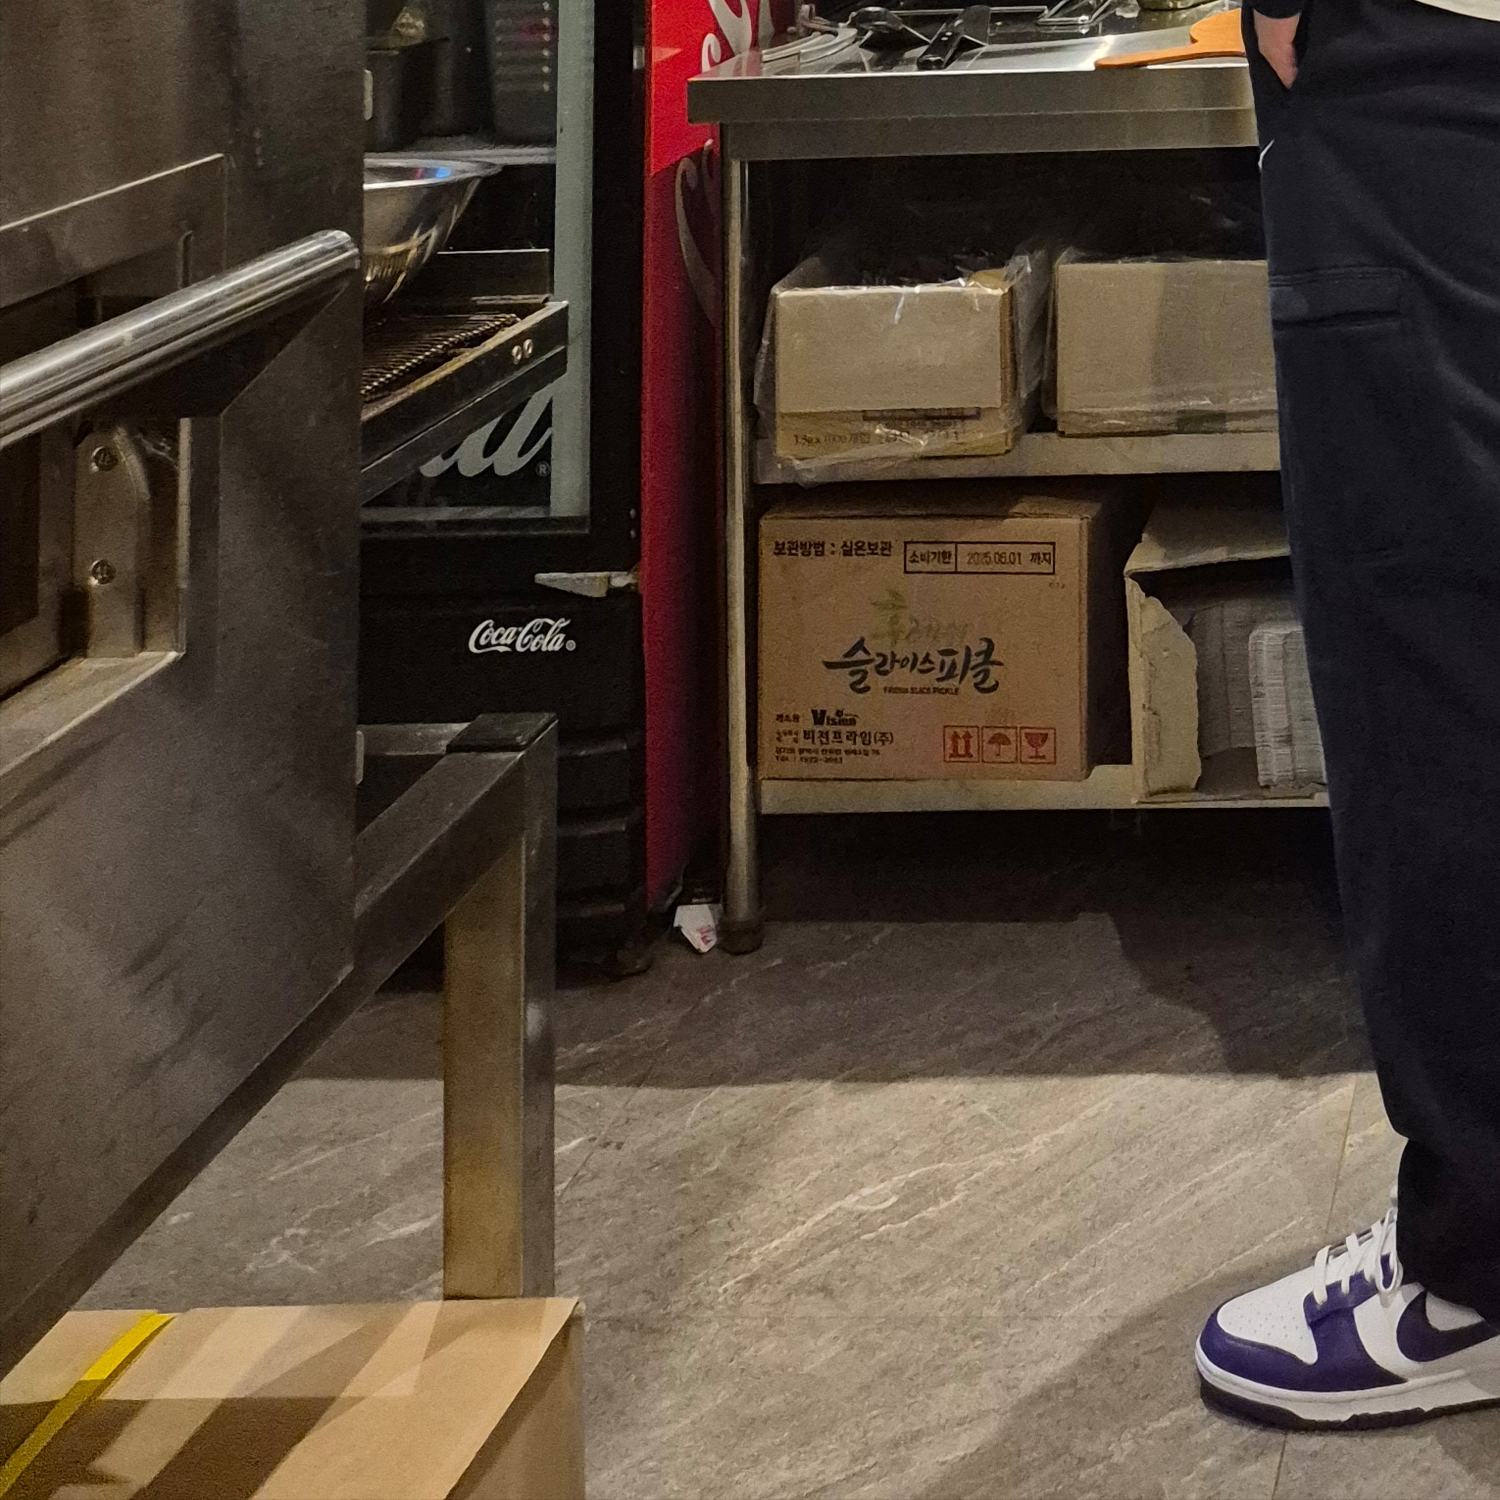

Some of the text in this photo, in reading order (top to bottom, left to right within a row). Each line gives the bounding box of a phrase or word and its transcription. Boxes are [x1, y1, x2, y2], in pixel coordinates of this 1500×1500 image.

[774, 541, 825, 557] 보관방법
[841, 541, 893, 557] 실온보관
[908, 550, 952, 564] 소비기한
[1029, 551, 1052, 565] 까지
[468, 618, 571, 654] Coca-Cola
